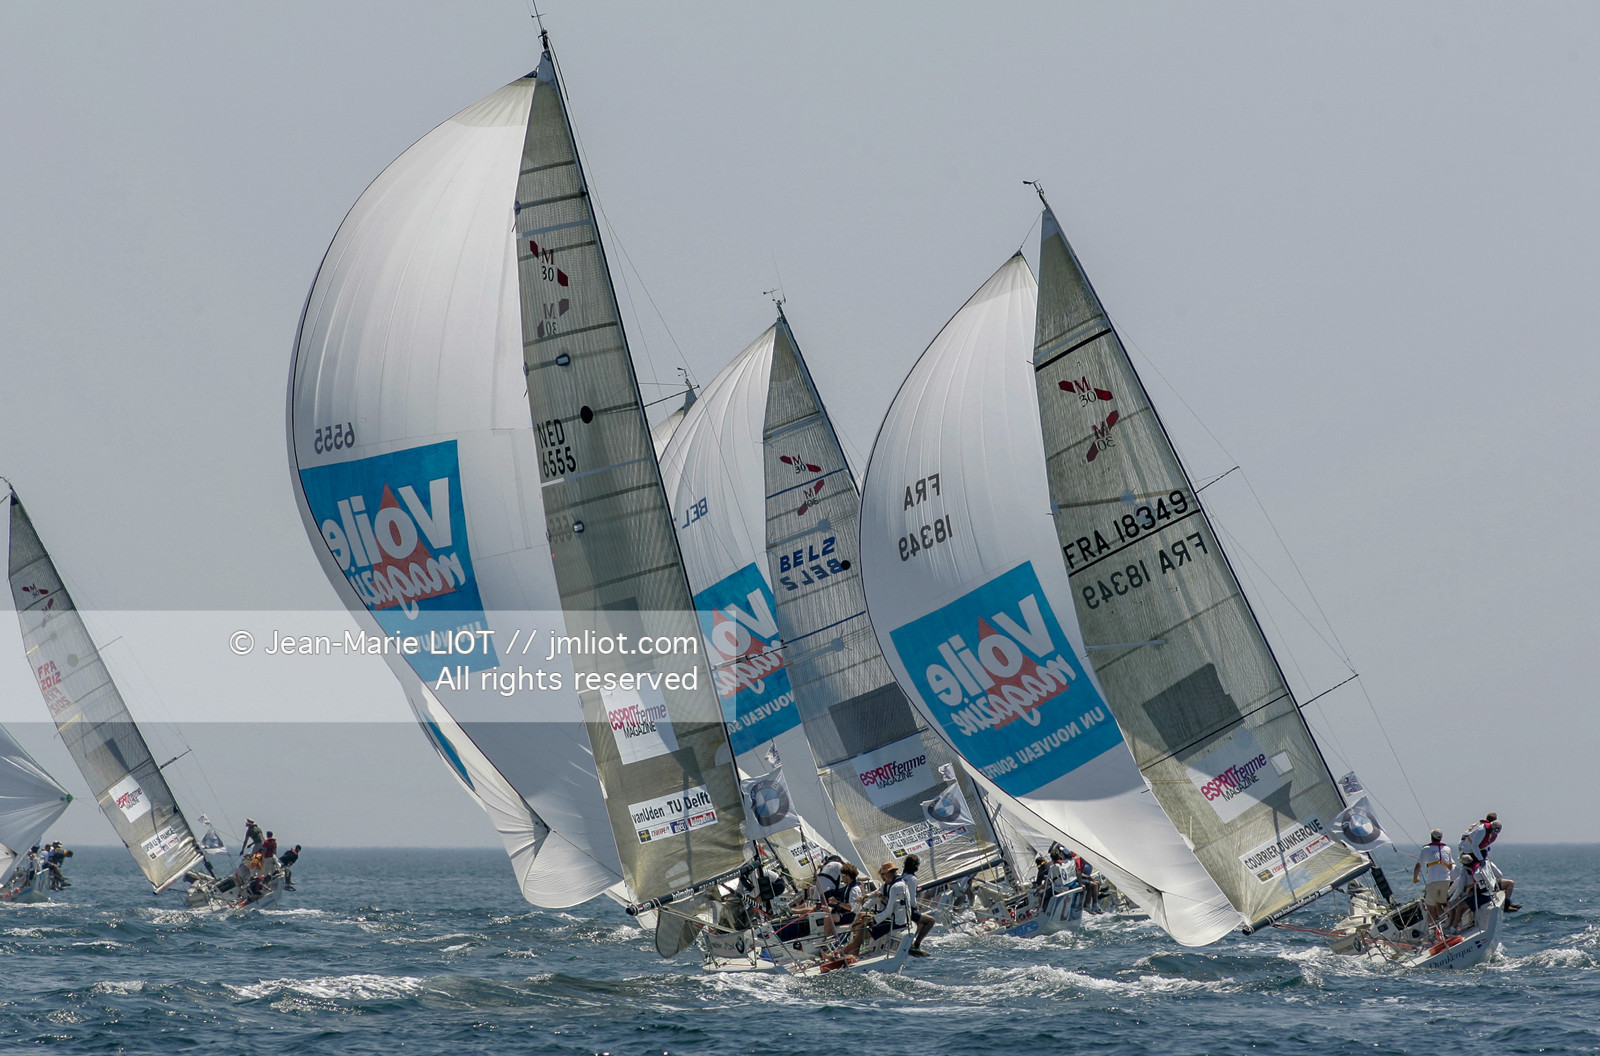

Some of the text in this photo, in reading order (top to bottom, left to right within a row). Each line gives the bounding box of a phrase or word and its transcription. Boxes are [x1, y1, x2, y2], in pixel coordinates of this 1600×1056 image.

[541, 247, 554, 265] M
[541, 265, 554, 281] 30
[1074, 376, 1091, 393] M
[1078, 391, 1097, 408] 30
[537, 419, 565, 449] NED
[542, 446, 576, 478] 6555
[1063, 490, 1188, 569] FRA 18349
[37, 660, 57, 679] FRA
[40, 671, 61, 691] 2012
[623, 721, 657, 739] MAGAZINE
[875, 770, 914, 790] MAGAZINE
[1221, 771, 1260, 802] MAGAZINE
[667, 799, 683, 814] TU
[683, 791, 711, 810] Delft
[1244, 844, 1281, 870] COURRIER
[1276, 818, 1324, 853] DUNKERQUE
